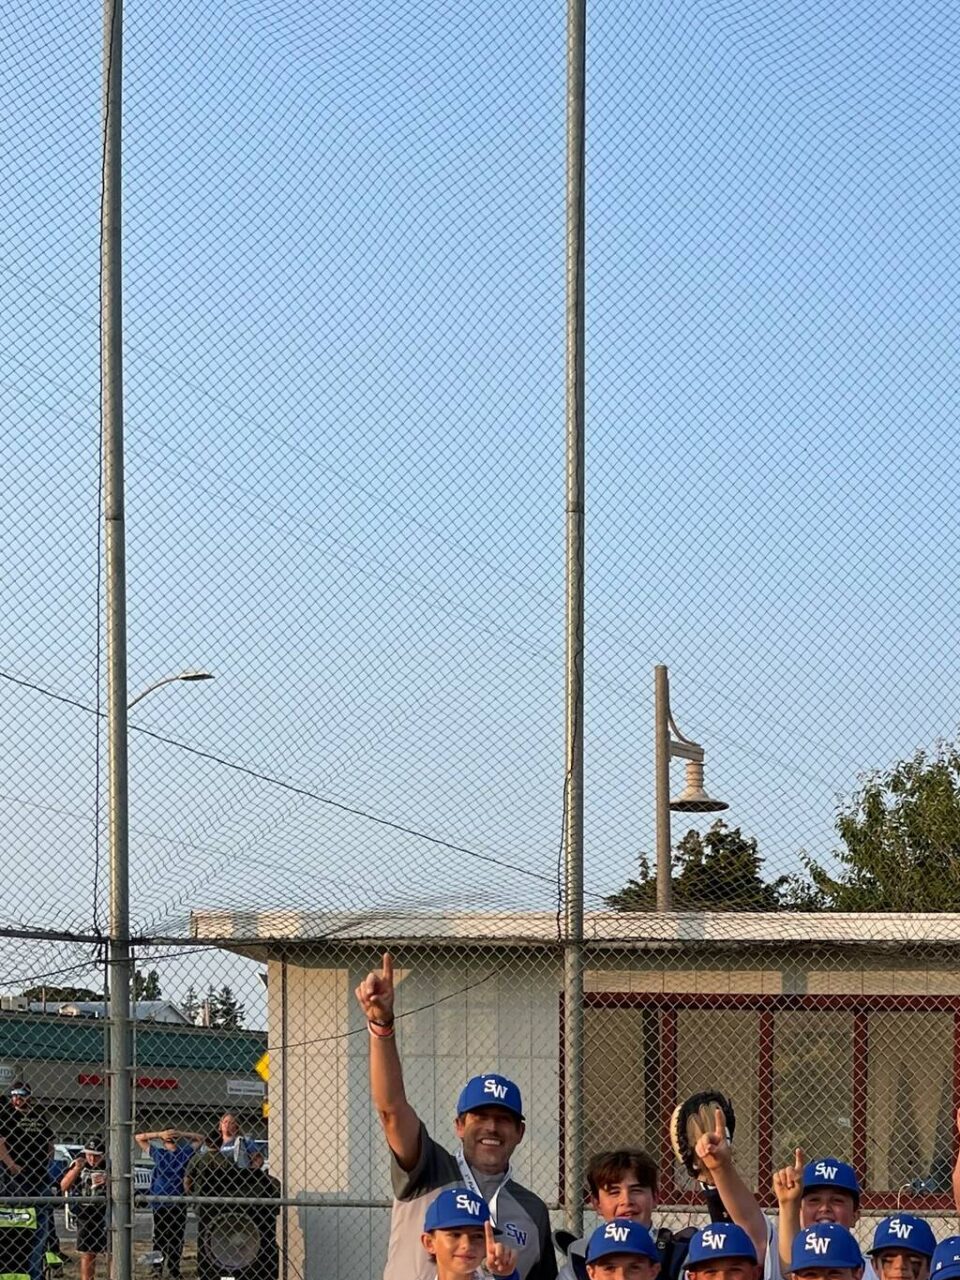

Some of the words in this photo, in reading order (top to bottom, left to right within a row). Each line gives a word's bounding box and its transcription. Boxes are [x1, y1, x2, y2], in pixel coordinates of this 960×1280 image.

[483, 1079, 508, 1099] SW
[814, 1162, 838, 1180] SW
[455, 1194, 481, 1216] SW
[505, 1222, 527, 1246] SW
[604, 1223, 630, 1242] SW
[887, 1218, 913, 1239] SW
[701, 1230, 726, 1249] SW
[804, 1232, 831, 1254] SW
